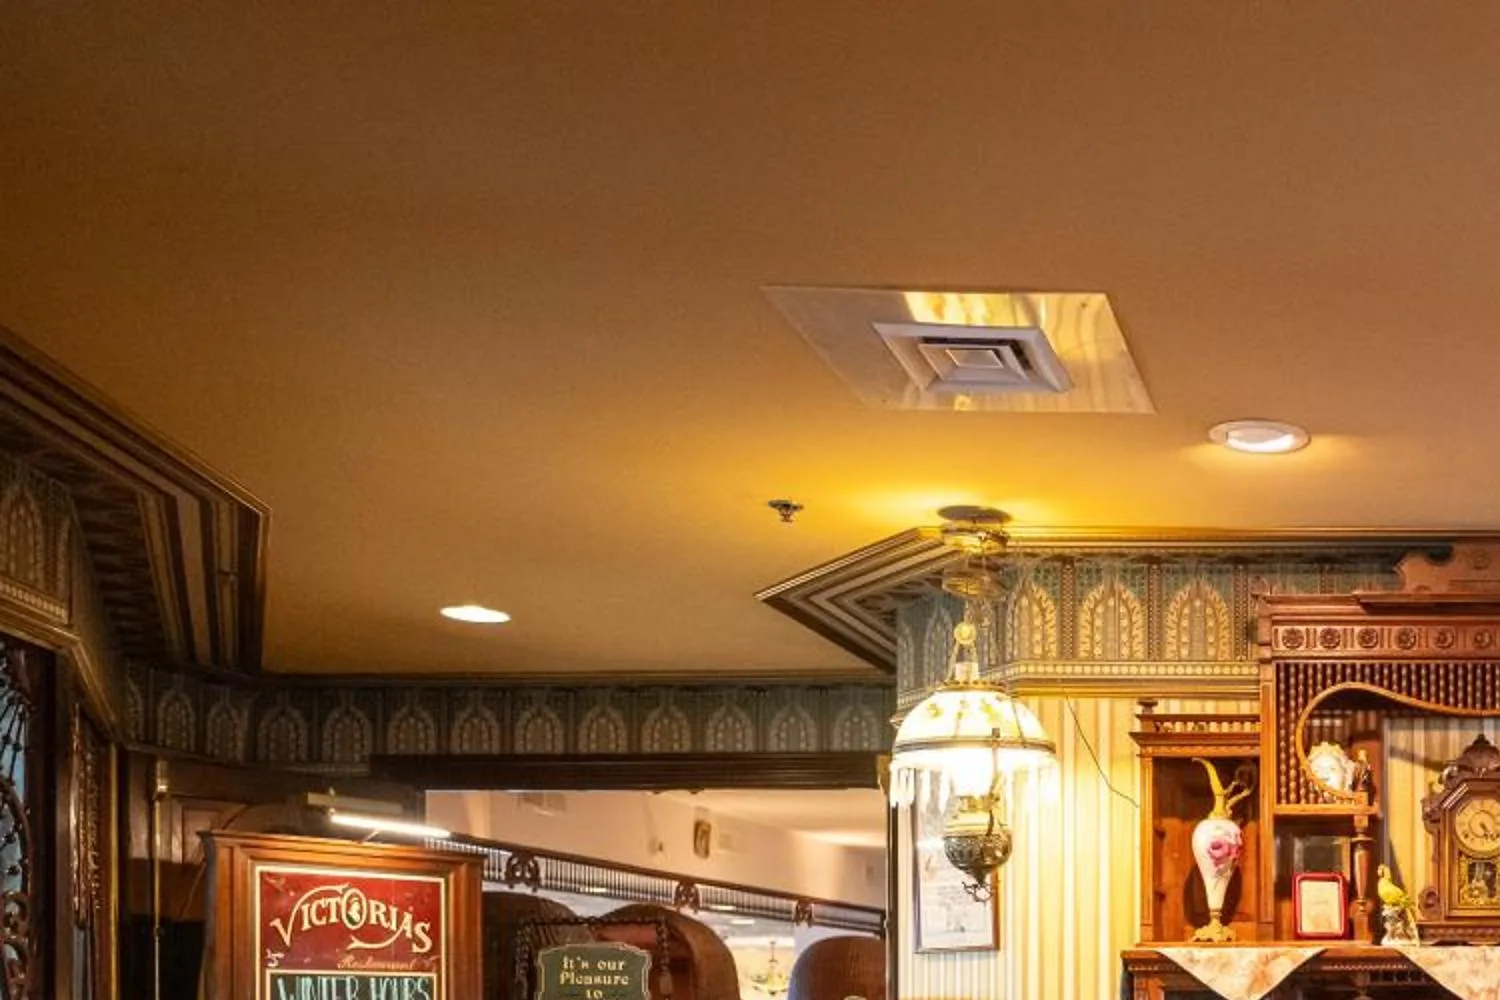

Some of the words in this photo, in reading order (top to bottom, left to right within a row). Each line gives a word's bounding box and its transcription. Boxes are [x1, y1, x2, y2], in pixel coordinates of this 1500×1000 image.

[597, 960, 625, 970] our
[560, 971, 629, 985] Pleasure
[585, 989, 603, 999] to
